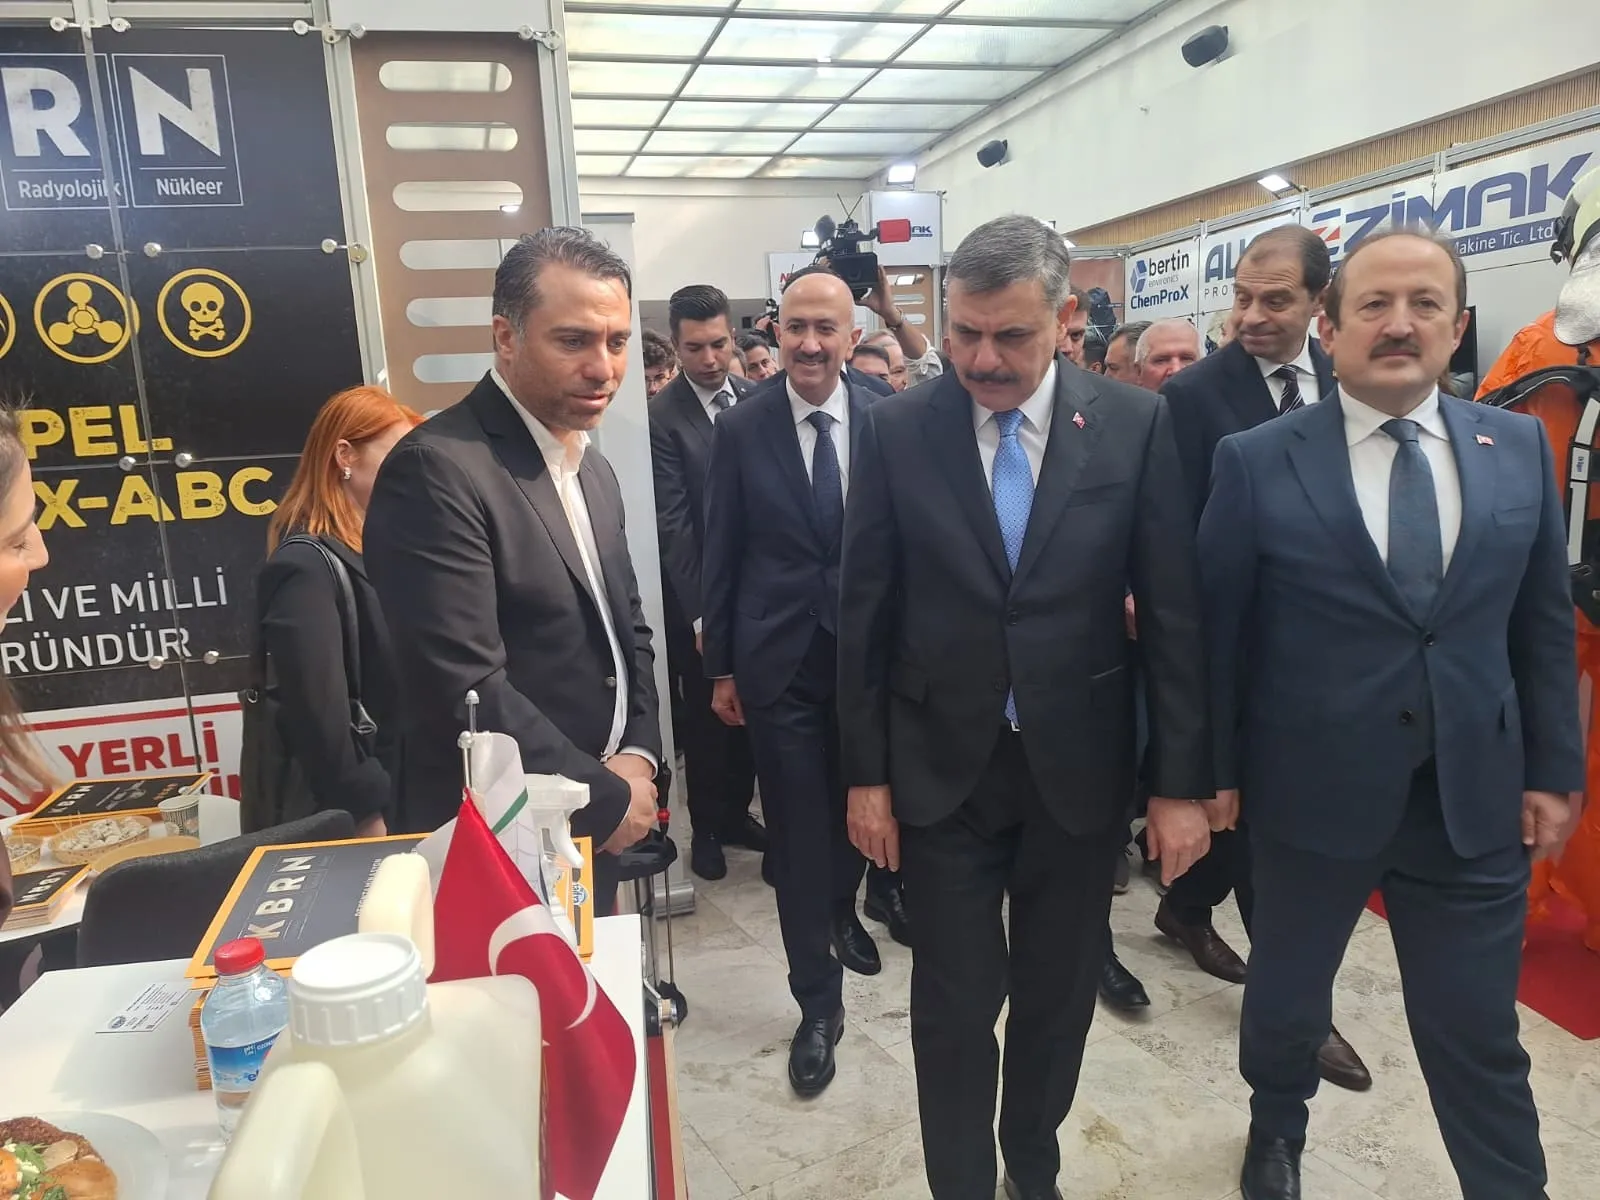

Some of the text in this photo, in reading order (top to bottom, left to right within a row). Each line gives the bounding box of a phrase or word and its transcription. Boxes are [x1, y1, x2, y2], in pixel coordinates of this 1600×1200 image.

[156, 178, 223, 197] Nükleer
[1501, 229, 1524, 247] Tic.
[1148, 249, 1190, 277] bertin
[1130, 284, 1190, 310] ChemProX
[41, 584, 101, 620] VE
[110, 566, 228, 615] MİLLİ
[58, 720, 219, 778] YERLİ
[244, 855, 317, 939] KBRN
